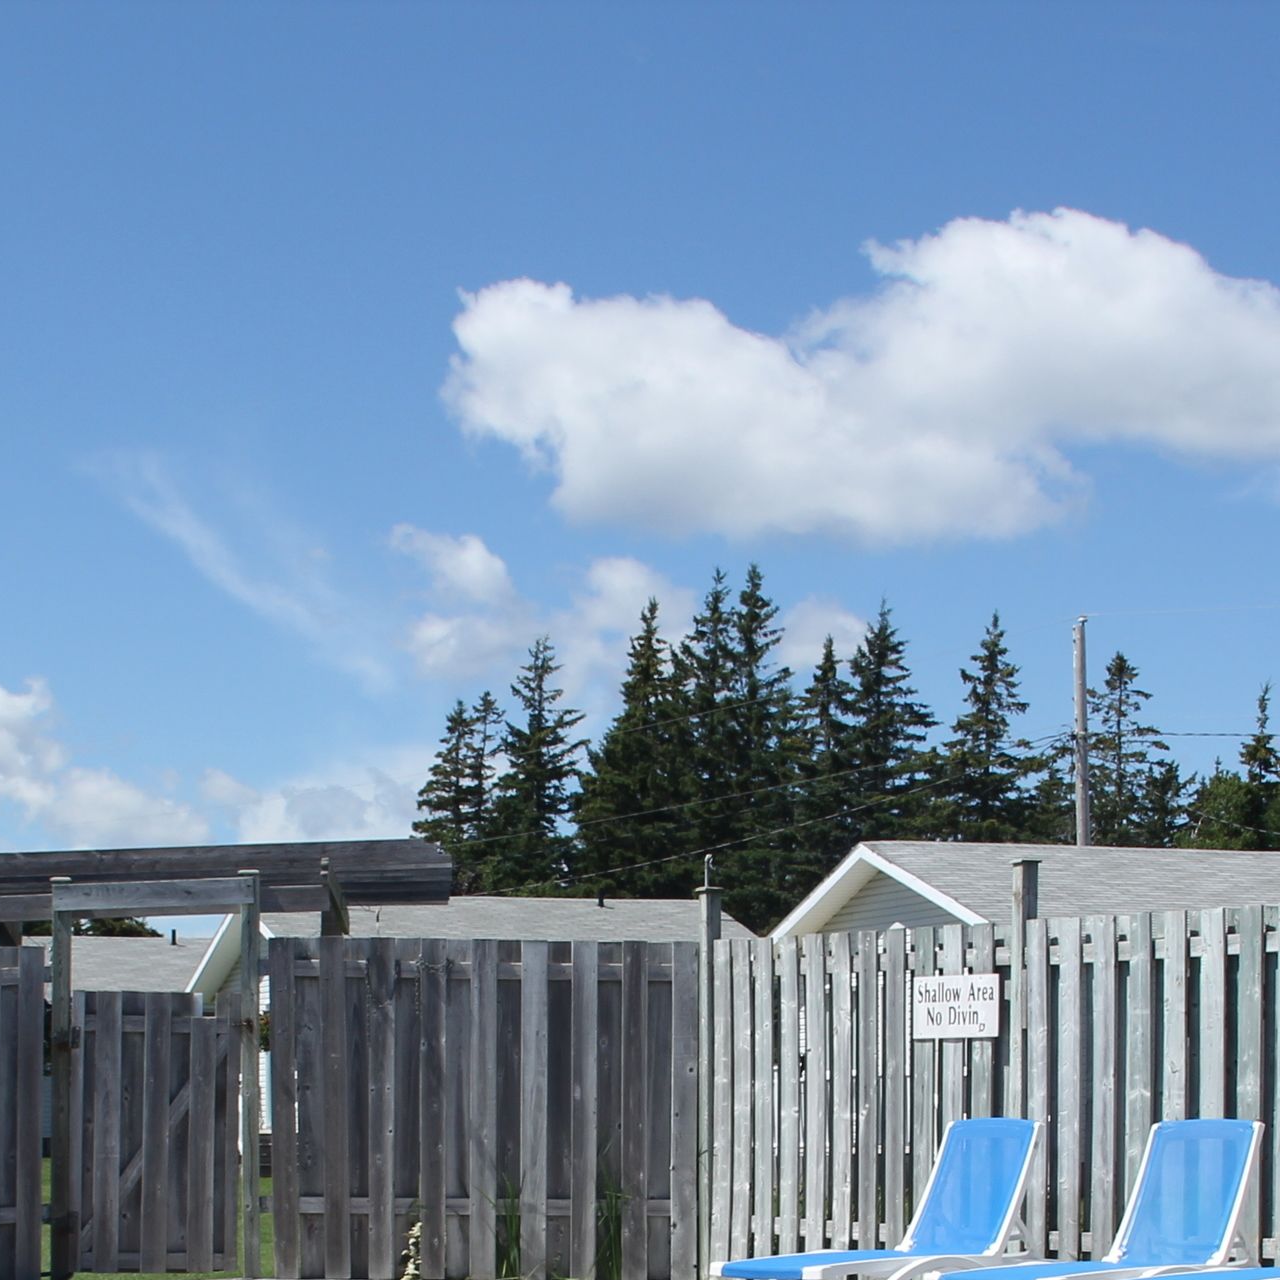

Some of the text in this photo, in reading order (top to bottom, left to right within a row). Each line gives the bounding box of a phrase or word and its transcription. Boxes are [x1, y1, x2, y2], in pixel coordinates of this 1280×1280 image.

[917, 982, 995, 1004] Shallow Area
[926, 1007, 943, 1026] No
